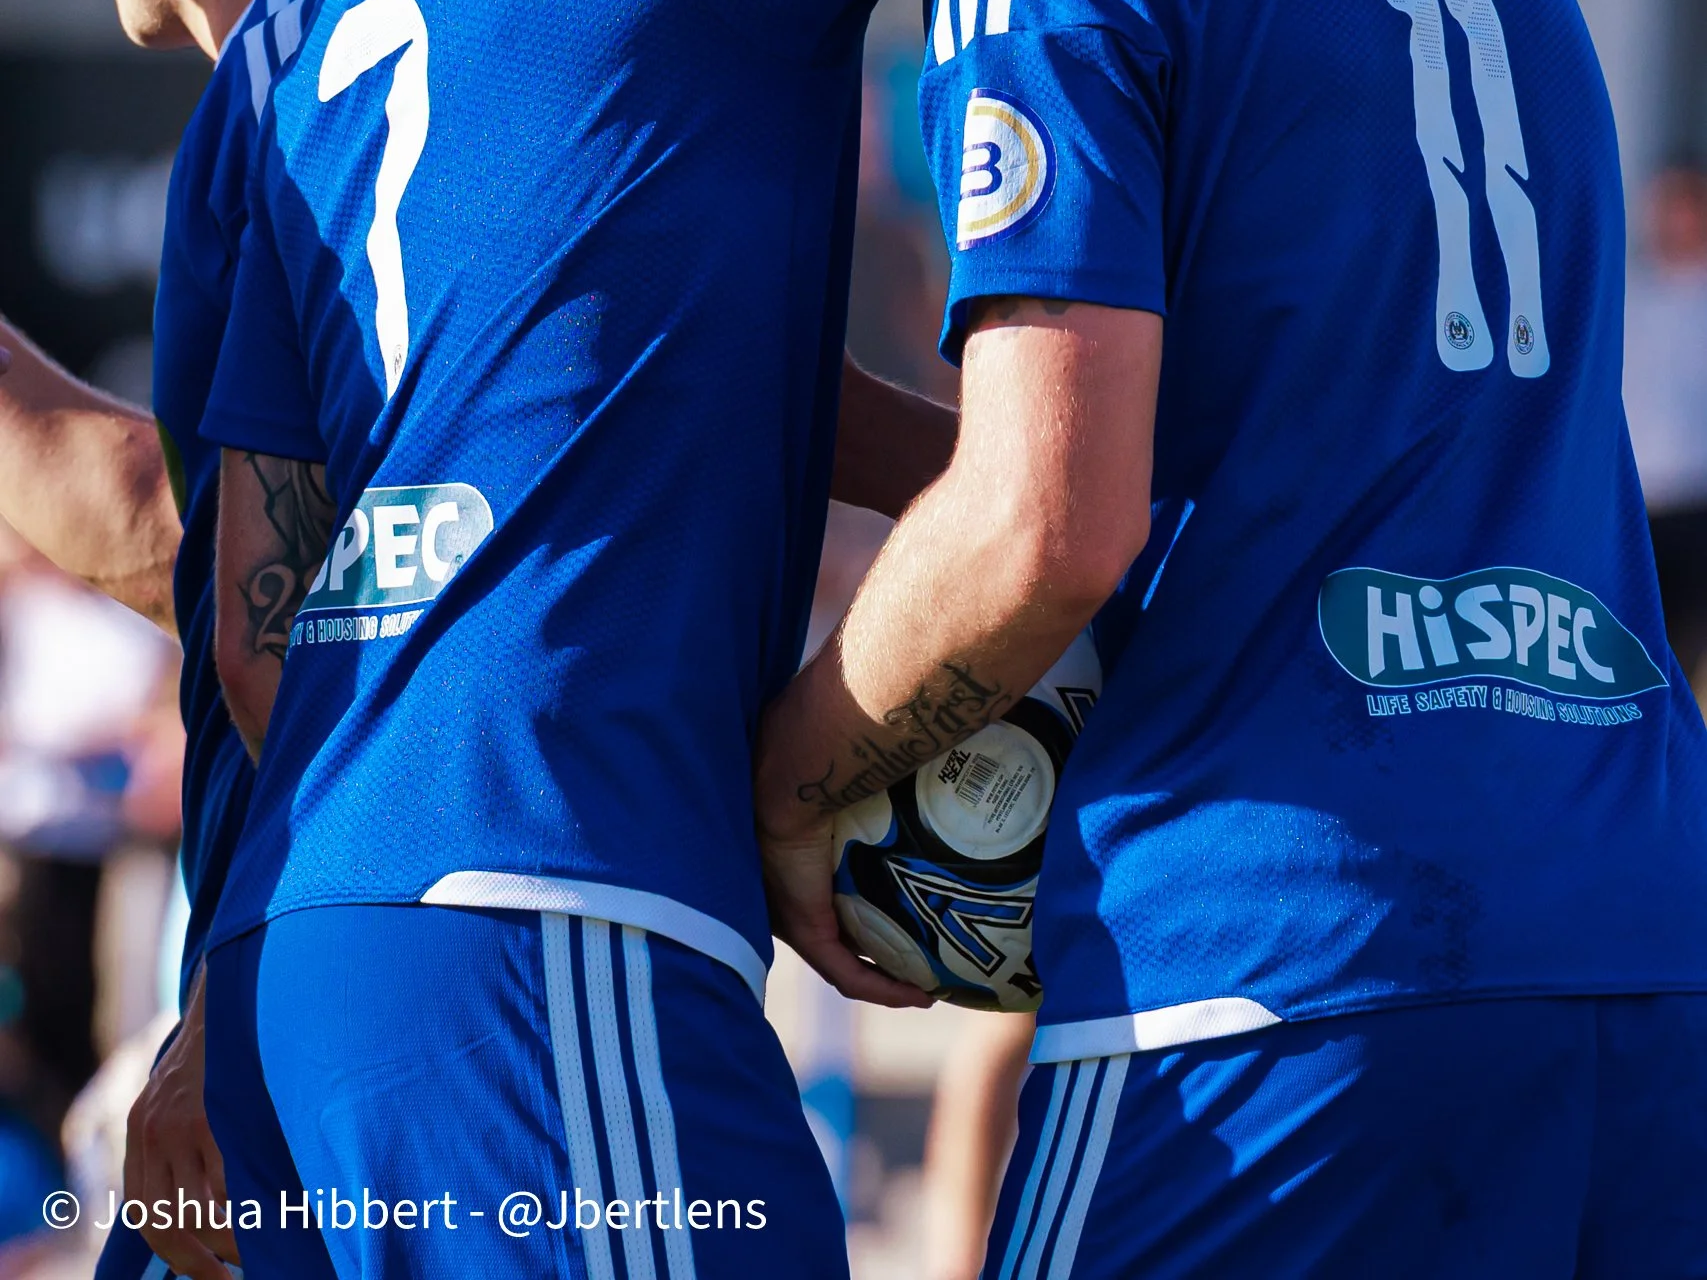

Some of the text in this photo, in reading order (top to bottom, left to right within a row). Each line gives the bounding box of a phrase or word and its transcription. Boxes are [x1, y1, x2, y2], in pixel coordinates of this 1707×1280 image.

[306, 620, 315, 644] &
[317, 616, 379, 643] HOUSING
[379, 609, 424, 639] SOLUT
[1367, 584, 1615, 683] HiSPEC
[1366, 685, 1643, 726] LIFE SAFETY & HOUSING SOLUTIONS
[938, 749, 959, 784] HYPER
[947, 750, 971, 783] SEAL
